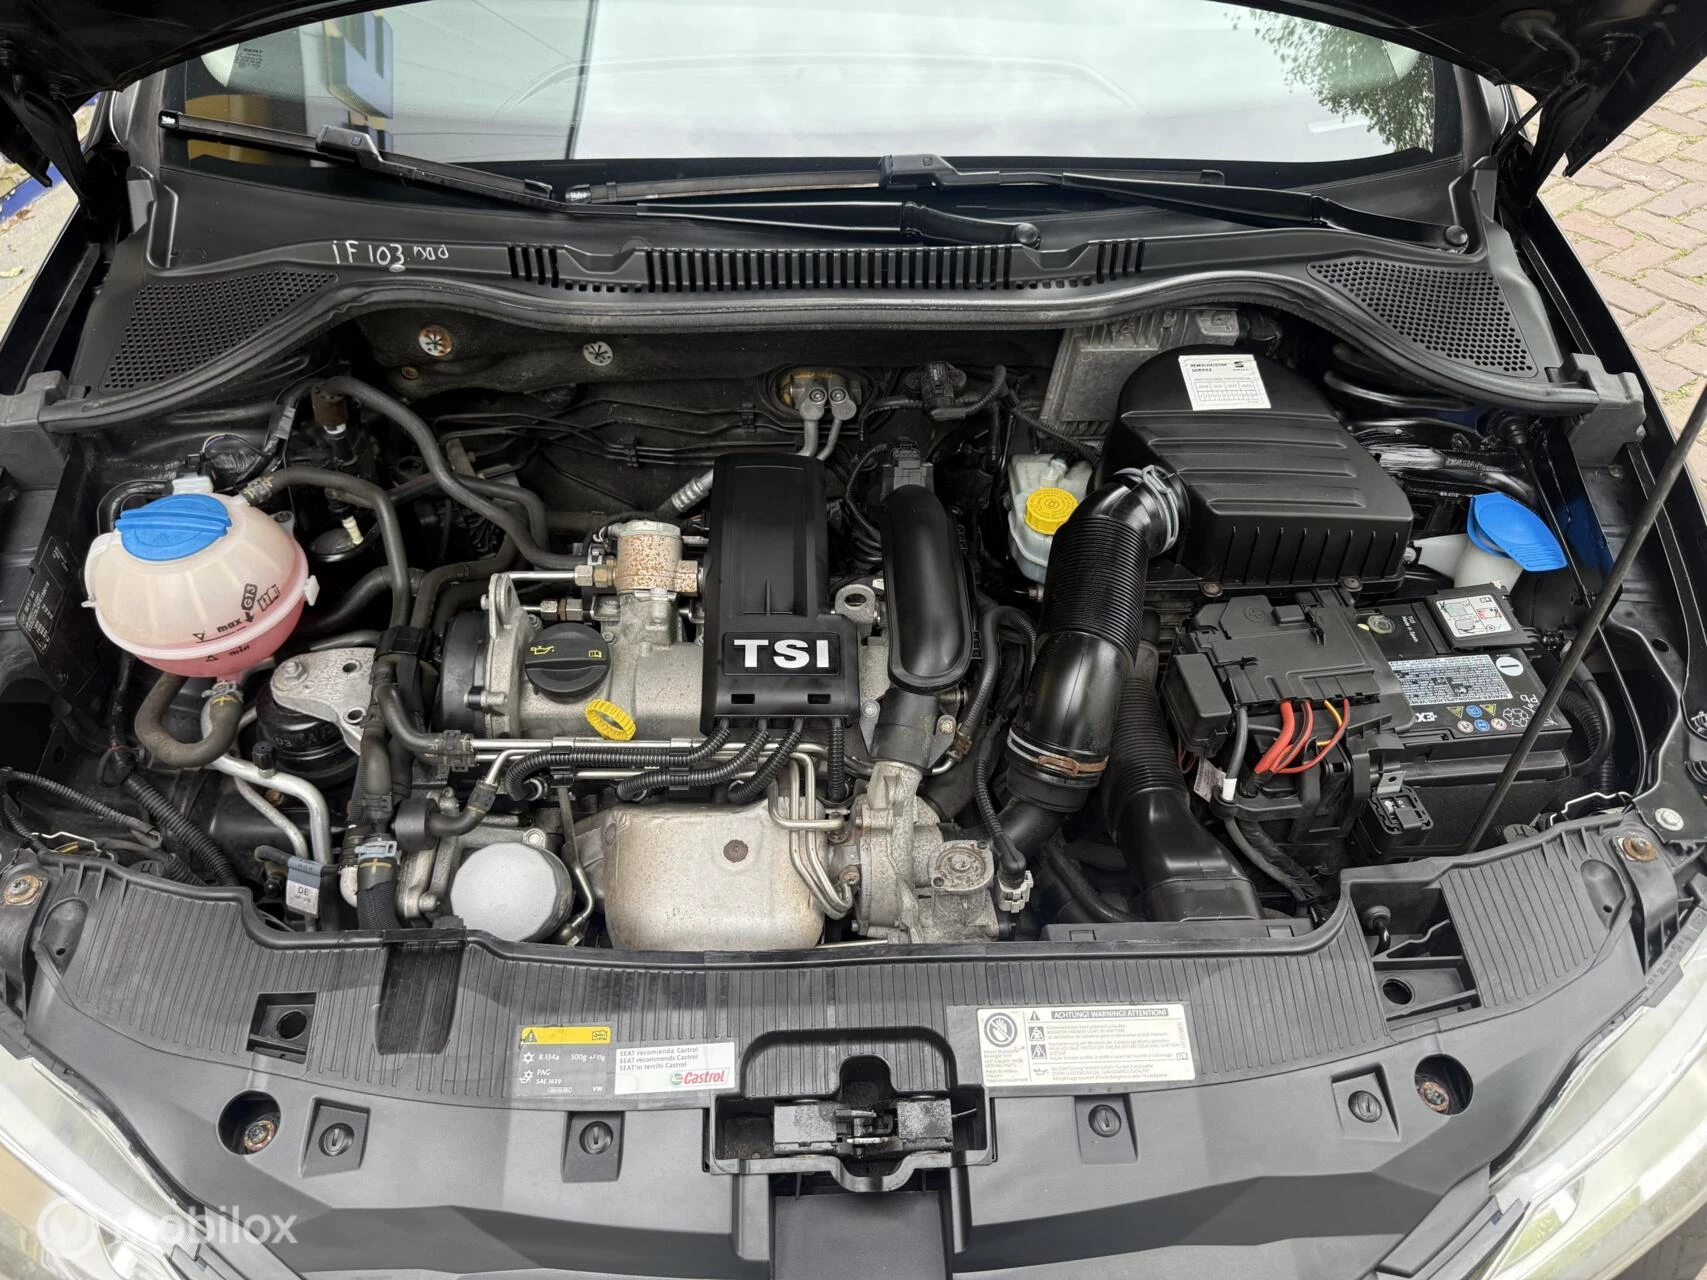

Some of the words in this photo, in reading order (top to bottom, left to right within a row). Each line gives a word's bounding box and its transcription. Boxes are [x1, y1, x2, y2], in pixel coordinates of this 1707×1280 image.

[242, 585, 256, 608] G13
[216, 618, 242, 633] max
[228, 644, 250, 657] min
[733, 639, 830, 669] TSI
[1053, 1010, 1089, 1019] ACHTUNG!
[1090, 1009, 1126, 1018] WARNING!
[1127, 1008, 1167, 1017] ATTENTION!
[637, 1048, 675, 1056] recomienda
[676, 1046, 699, 1054] Castrol
[636, 1055, 676, 1063] recommends
[676, 1053, 699, 1061] Castrol
[665, 1061, 687, 1069] Castrol
[536, 1068, 551, 1076] PAG
[683, 1070, 726, 1085] Castrol
[592, 1085, 604, 1093] VW
